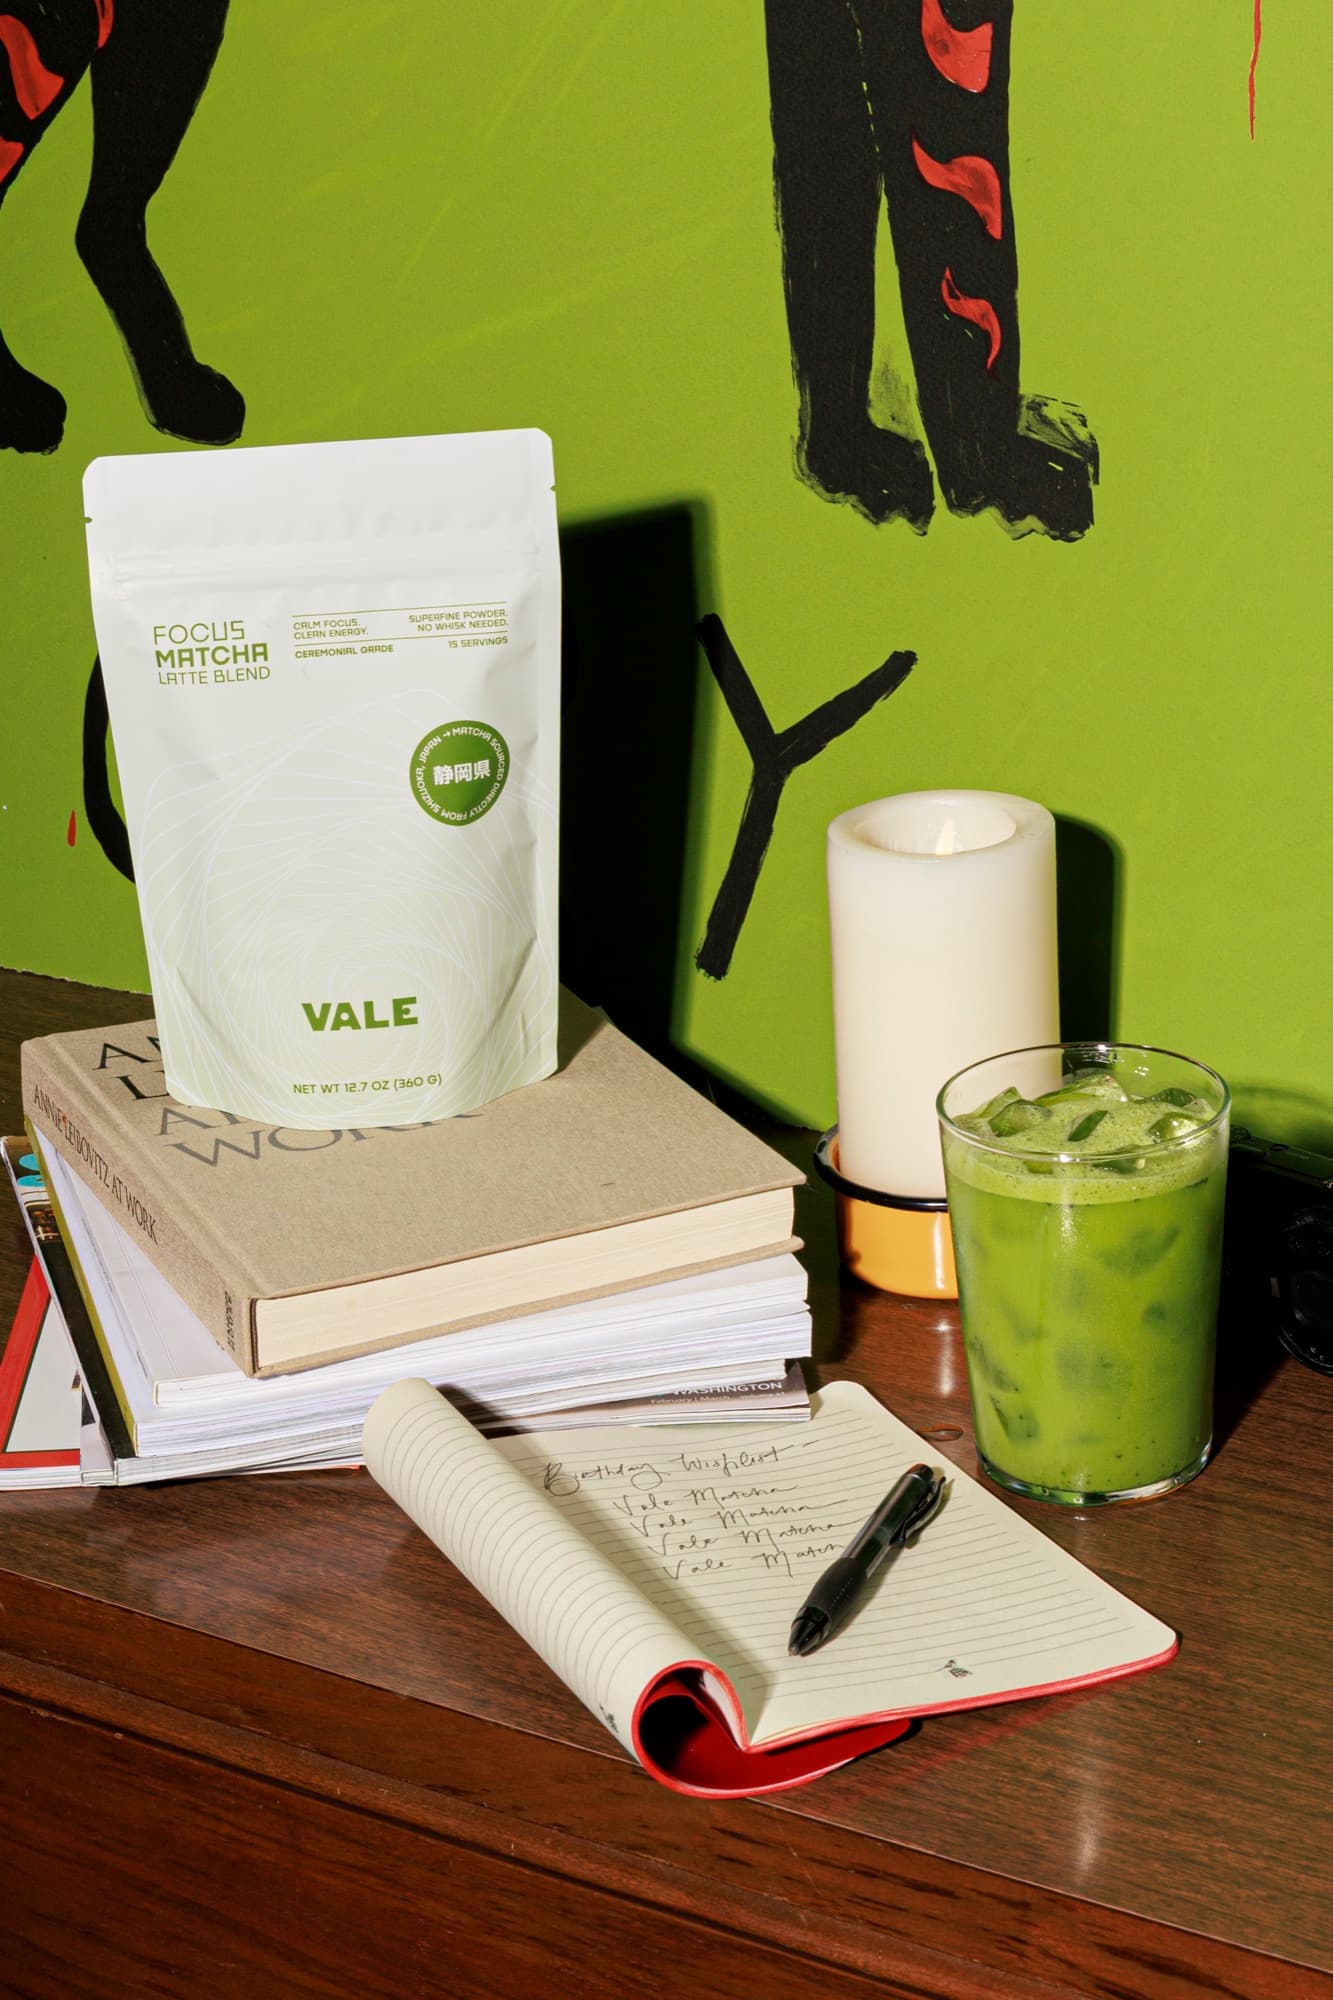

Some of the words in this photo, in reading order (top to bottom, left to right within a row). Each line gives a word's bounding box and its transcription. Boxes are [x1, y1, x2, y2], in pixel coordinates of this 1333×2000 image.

[293, 620, 321, 630] CALM
[323, 618, 360, 628] FOCUS.
[408, 612, 460, 623] SUPERFINE
[463, 609, 508, 619] POWDER.
[417, 623, 433, 632] NO
[435, 621, 466, 631] WHISK
[469, 618, 509, 629] NEEDED.
[153, 620, 245, 645] FOCUS
[294, 630, 326, 640] CLEAN
[328, 627, 368, 638] ENERGY.
[448, 639, 458, 648] 15
[460, 635, 508, 647] SERVINGS
[155, 643, 269, 668] MATCHA
[295, 647, 358, 659] CEREMONIAL
[360, 644, 394, 654] GRADE
[158, 671, 208, 685] LATTE
[213, 666, 271, 683] BLEND
[452, 726, 492, 741] MATCHA
[418, 735, 442, 763] JAPAN
[490, 738, 505, 781] SOURCED
[433, 759, 491, 786] 静岡県
[468, 782, 500, 817] DIRECTLY
[441, 809, 468, 821] FROM
[301, 996, 418, 1031] VALE
[293, 1083, 317, 1095] NET
[320, 1083, 340, 1094] WT
[344, 1081, 368, 1092] 12.7
[371, 1080, 390, 1091] OZ
[393, 1076, 424, 1092] (360
[427, 1073, 442, 1086] G)
[33, 1084, 63, 1133] ANNIE
[63, 1120, 110, 1189] LEIBOVITZ
[111, 1175, 124, 1204] AT
[124, 1186, 158, 1245] WORK
[672, 1381, 783, 1396] WASHINGTON
